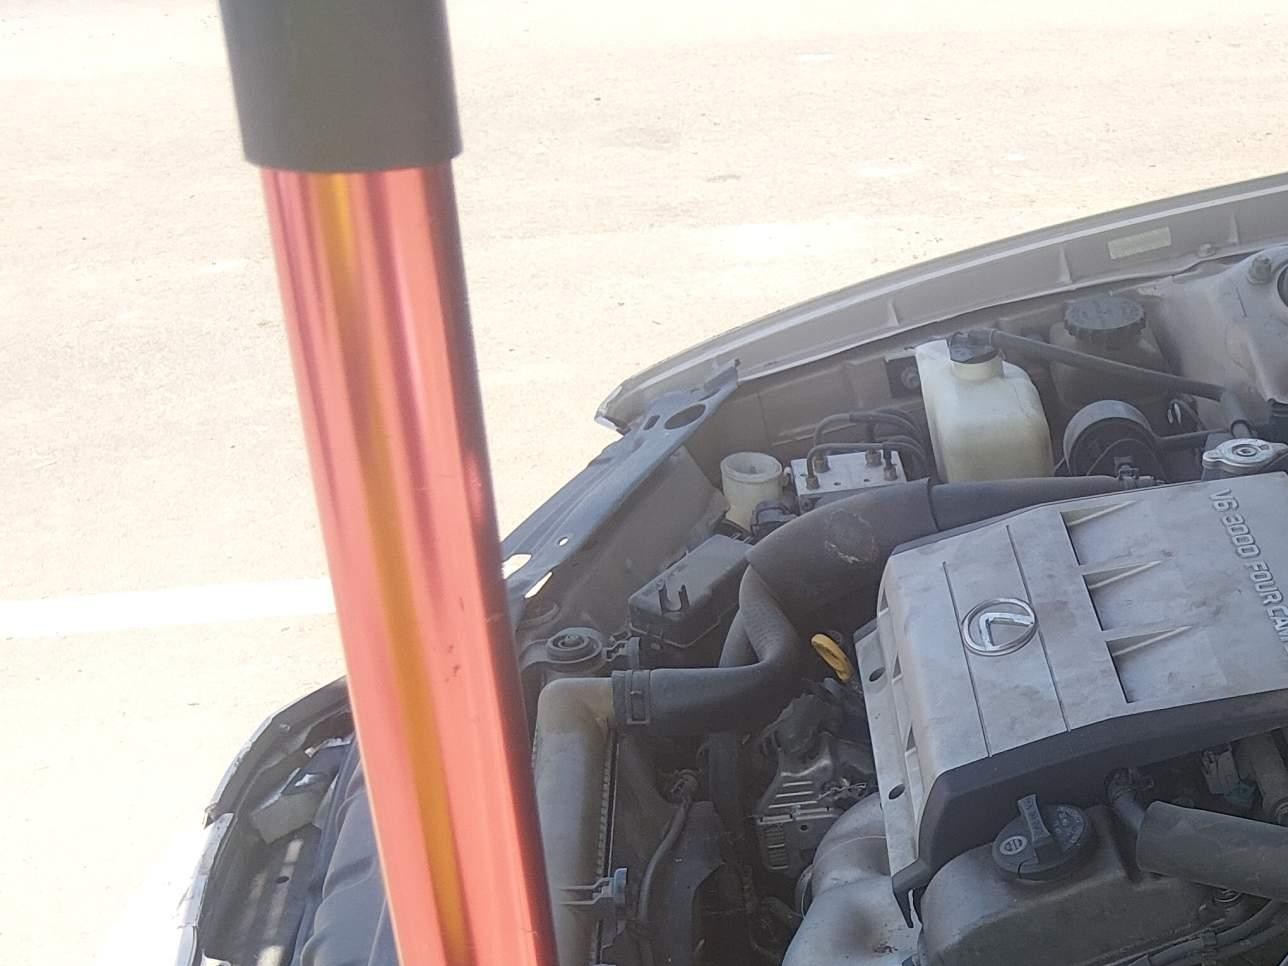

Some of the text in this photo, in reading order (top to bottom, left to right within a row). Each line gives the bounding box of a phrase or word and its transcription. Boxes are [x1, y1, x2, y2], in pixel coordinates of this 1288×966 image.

[1209, 488, 1239, 511] V6
[1221, 513, 1261, 559] 3000
[1244, 561, 1282, 606] FOUR
